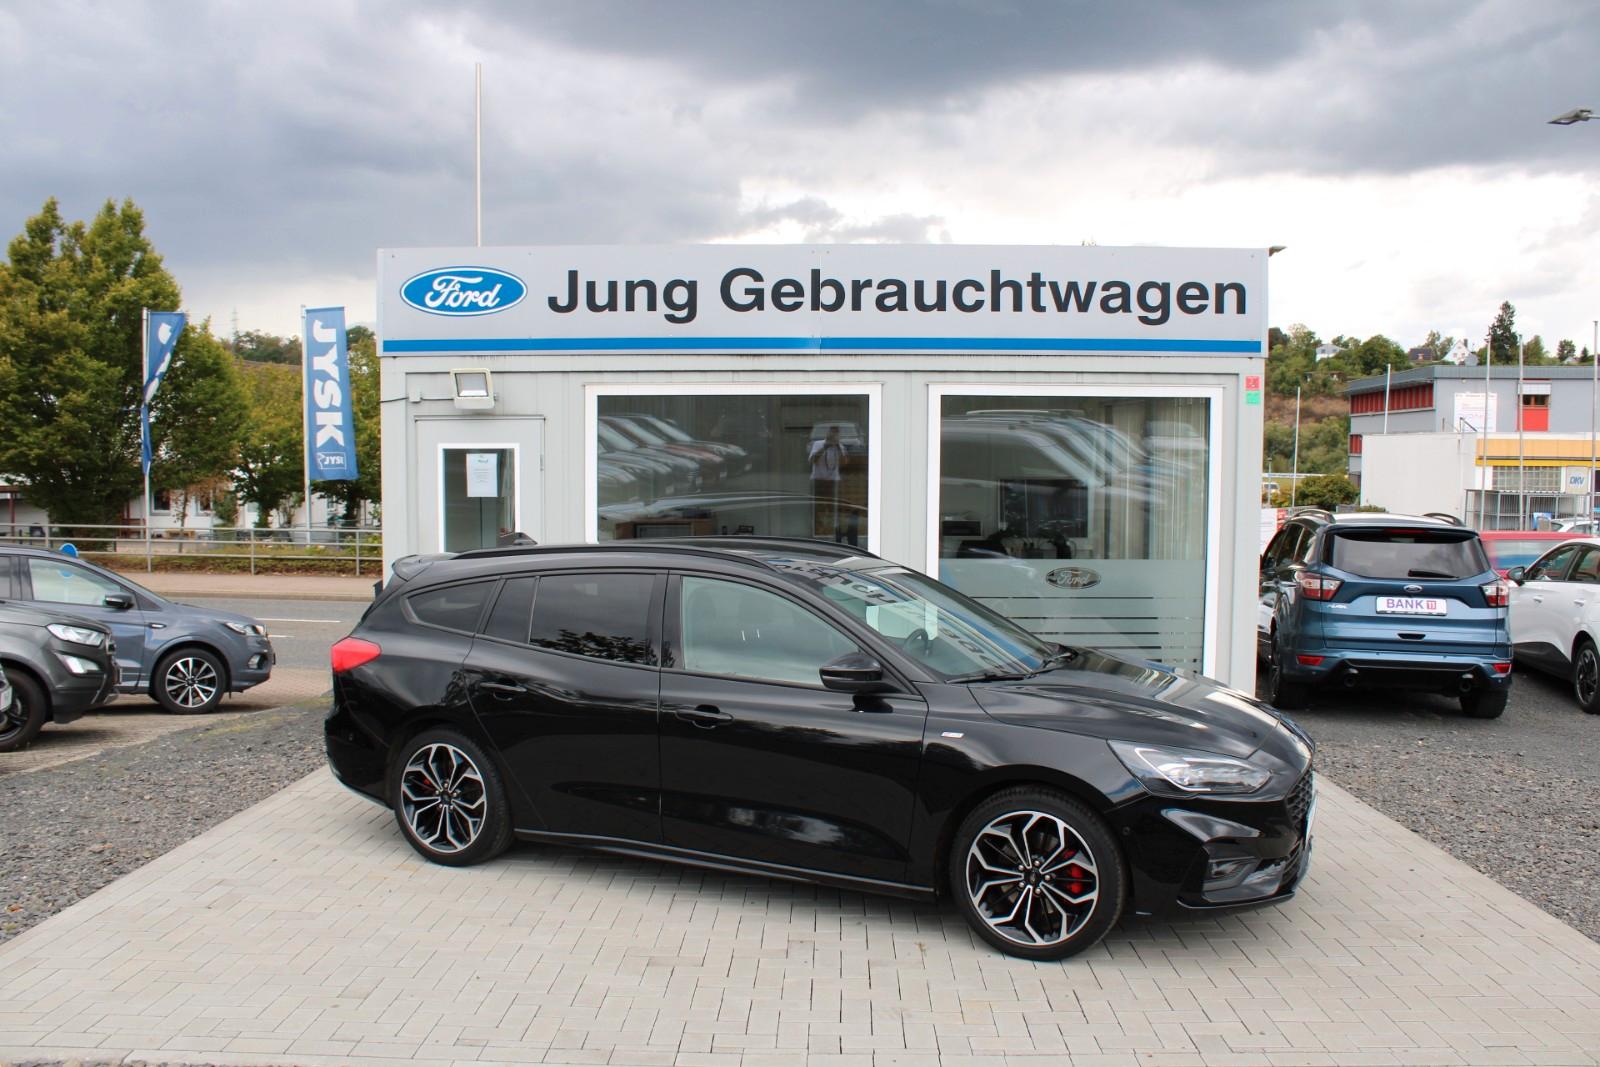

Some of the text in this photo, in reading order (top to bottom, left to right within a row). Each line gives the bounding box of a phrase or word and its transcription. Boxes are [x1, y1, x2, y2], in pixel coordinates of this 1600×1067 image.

[424, 275, 503, 309] Ford
[547, 267, 1246, 326] Jung Gebrauchtwagen
[313, 319, 345, 448] JYSK
[1569, 476, 1584, 485] DKV
[1057, 570, 1091, 585] Ford
[1386, 599, 1424, 609] BANK
